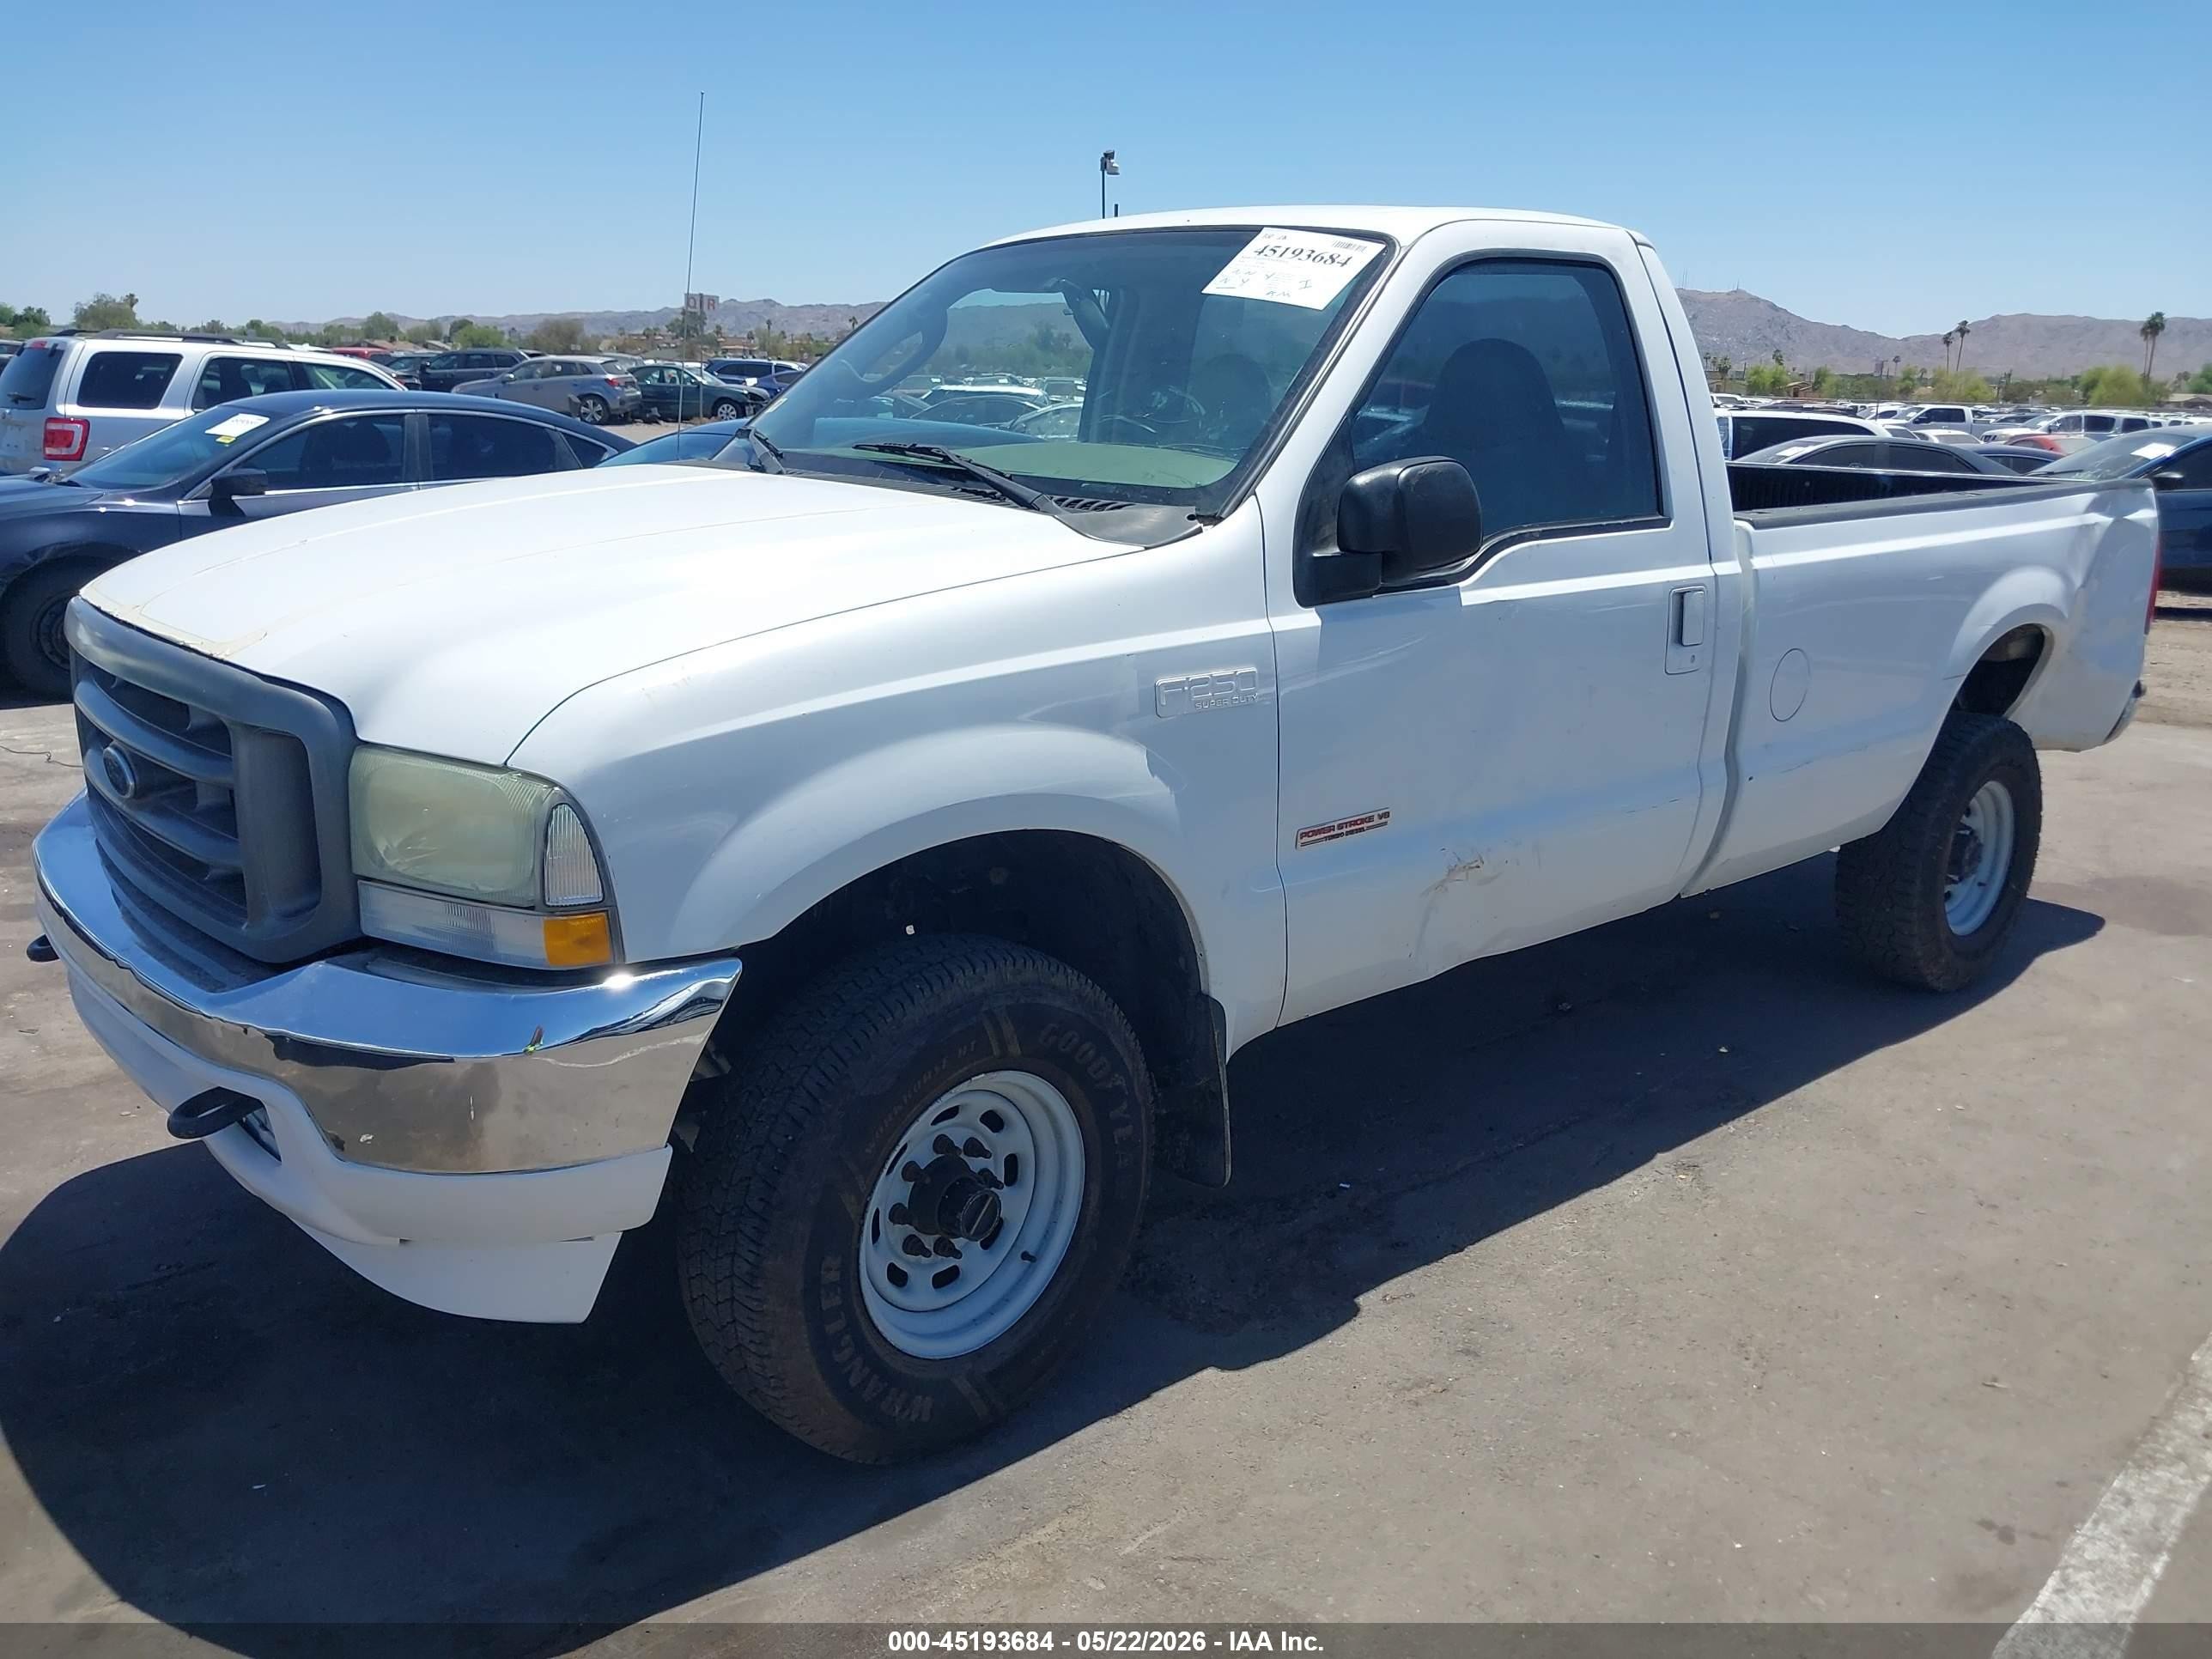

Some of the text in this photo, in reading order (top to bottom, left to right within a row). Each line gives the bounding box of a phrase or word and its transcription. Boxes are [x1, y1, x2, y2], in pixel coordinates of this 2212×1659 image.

[1254, 245, 1353, 268] 45193684
[1195, 692, 1259, 709] SUPER DUTY
[1299, 824, 1335, 840] POWER
[1336, 814, 1375, 830] STROKE
[820, 1254, 935, 1423] WRANGLER
